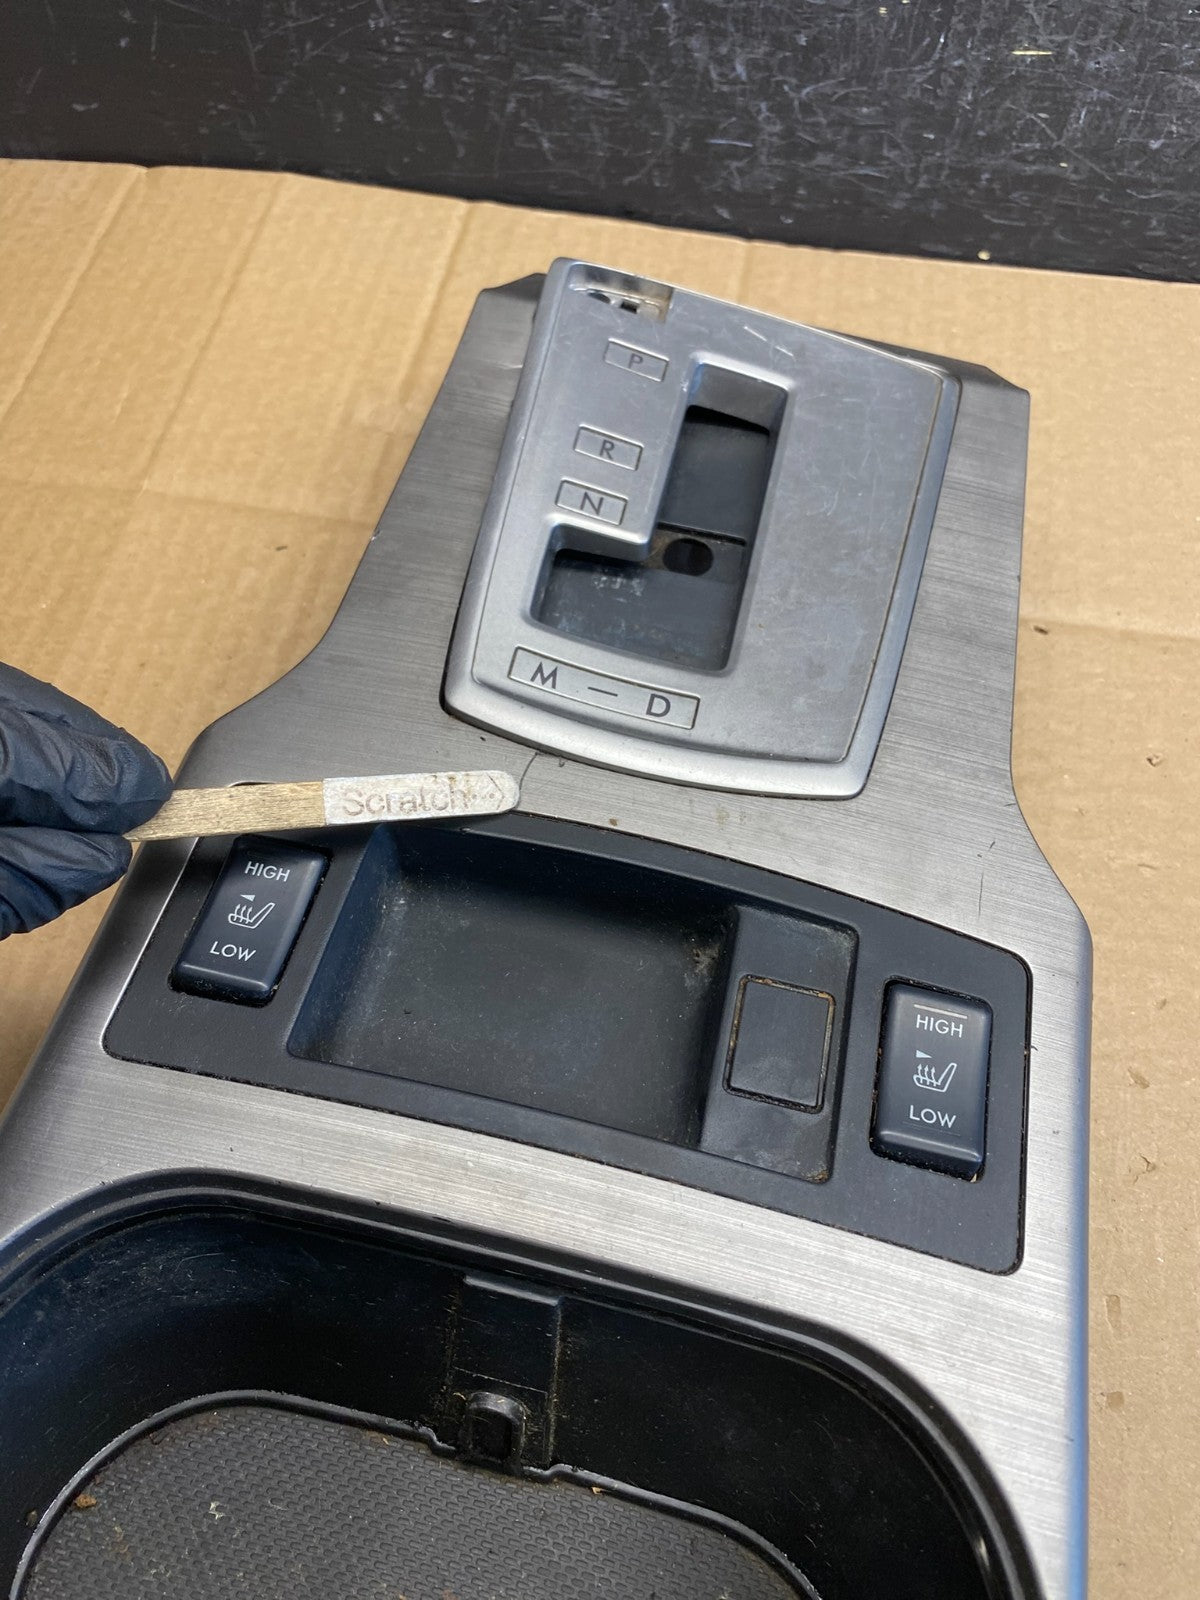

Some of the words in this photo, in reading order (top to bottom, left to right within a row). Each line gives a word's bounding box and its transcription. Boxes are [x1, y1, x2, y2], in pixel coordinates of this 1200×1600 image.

[628, 355, 644, 370] P
[600, 440, 615, 460] R
[581, 492, 604, 516] N
[530, 661, 557, 690] M
[646, 693, 672, 719] D
[344, 780, 470, 816] Scratch
[244, 861, 291, 882] HIGH
[209, 941, 257, 962] LOW
[916, 1014, 963, 1038] HIGH
[909, 1104, 957, 1129] LOW
